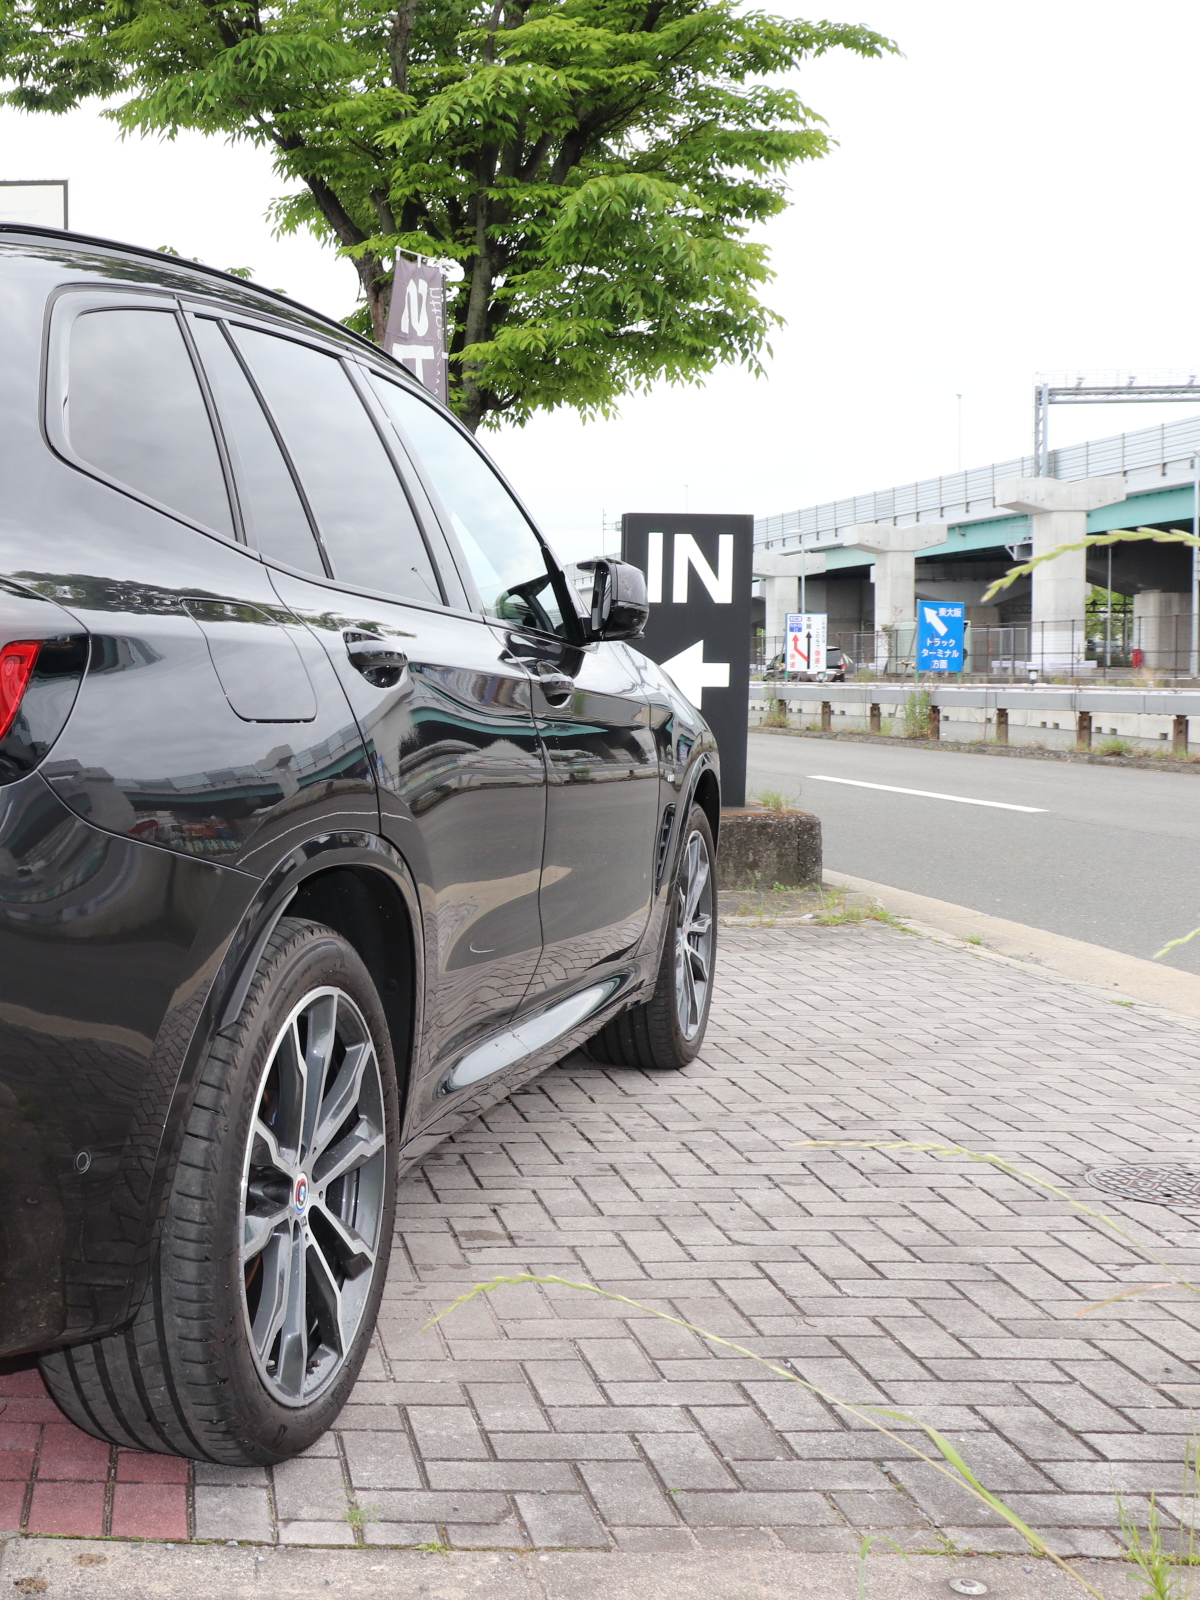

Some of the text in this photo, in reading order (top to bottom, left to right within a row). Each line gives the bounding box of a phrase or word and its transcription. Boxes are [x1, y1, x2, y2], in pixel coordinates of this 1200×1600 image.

[648, 532, 734, 604] IN
[939, 608, 962, 617] 東大阪
[927, 638, 955, 647] トラック
[921, 649, 959, 657] ターミナル
[932, 660, 948, 668] 方面
